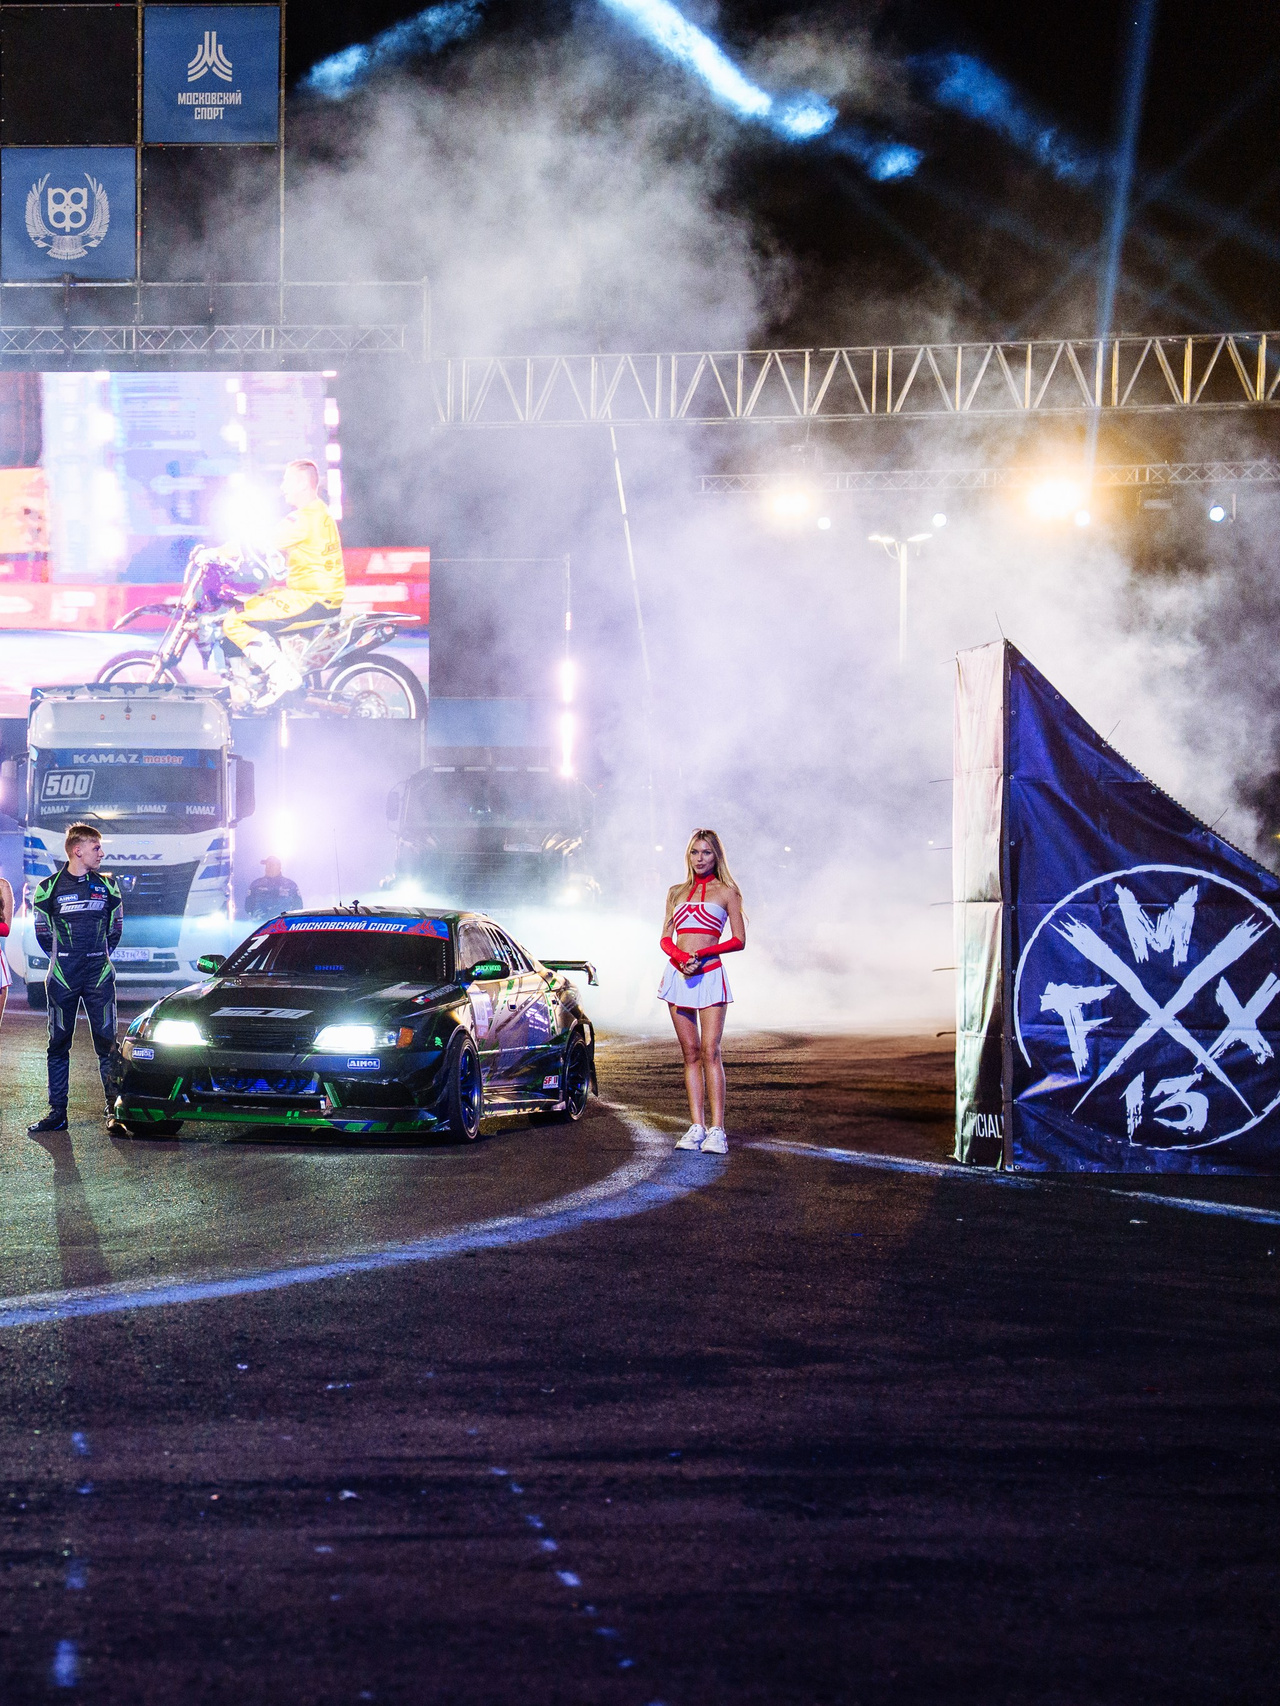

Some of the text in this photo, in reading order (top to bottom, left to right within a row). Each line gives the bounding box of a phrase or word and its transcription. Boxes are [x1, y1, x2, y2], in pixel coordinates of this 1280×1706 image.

[177, 89, 242, 105] МОСКОВСКИЙ
[194, 107, 224, 120] СПОРТ
[73, 753, 184, 765] KAMAZ master
[45, 774, 91, 796] 500
[40, 805, 70, 815] KAMAZ
[136, 804, 168, 814] KAMAZ
[185, 805, 216, 816] KAMAZ
[105, 853, 164, 861] AMAZ
[288, 920, 408, 933] МОСКОВСКИЙ СПОРТ
[348, 1060, 379, 1068] AIMOL
[1119, 1070, 1210, 1148] 13
